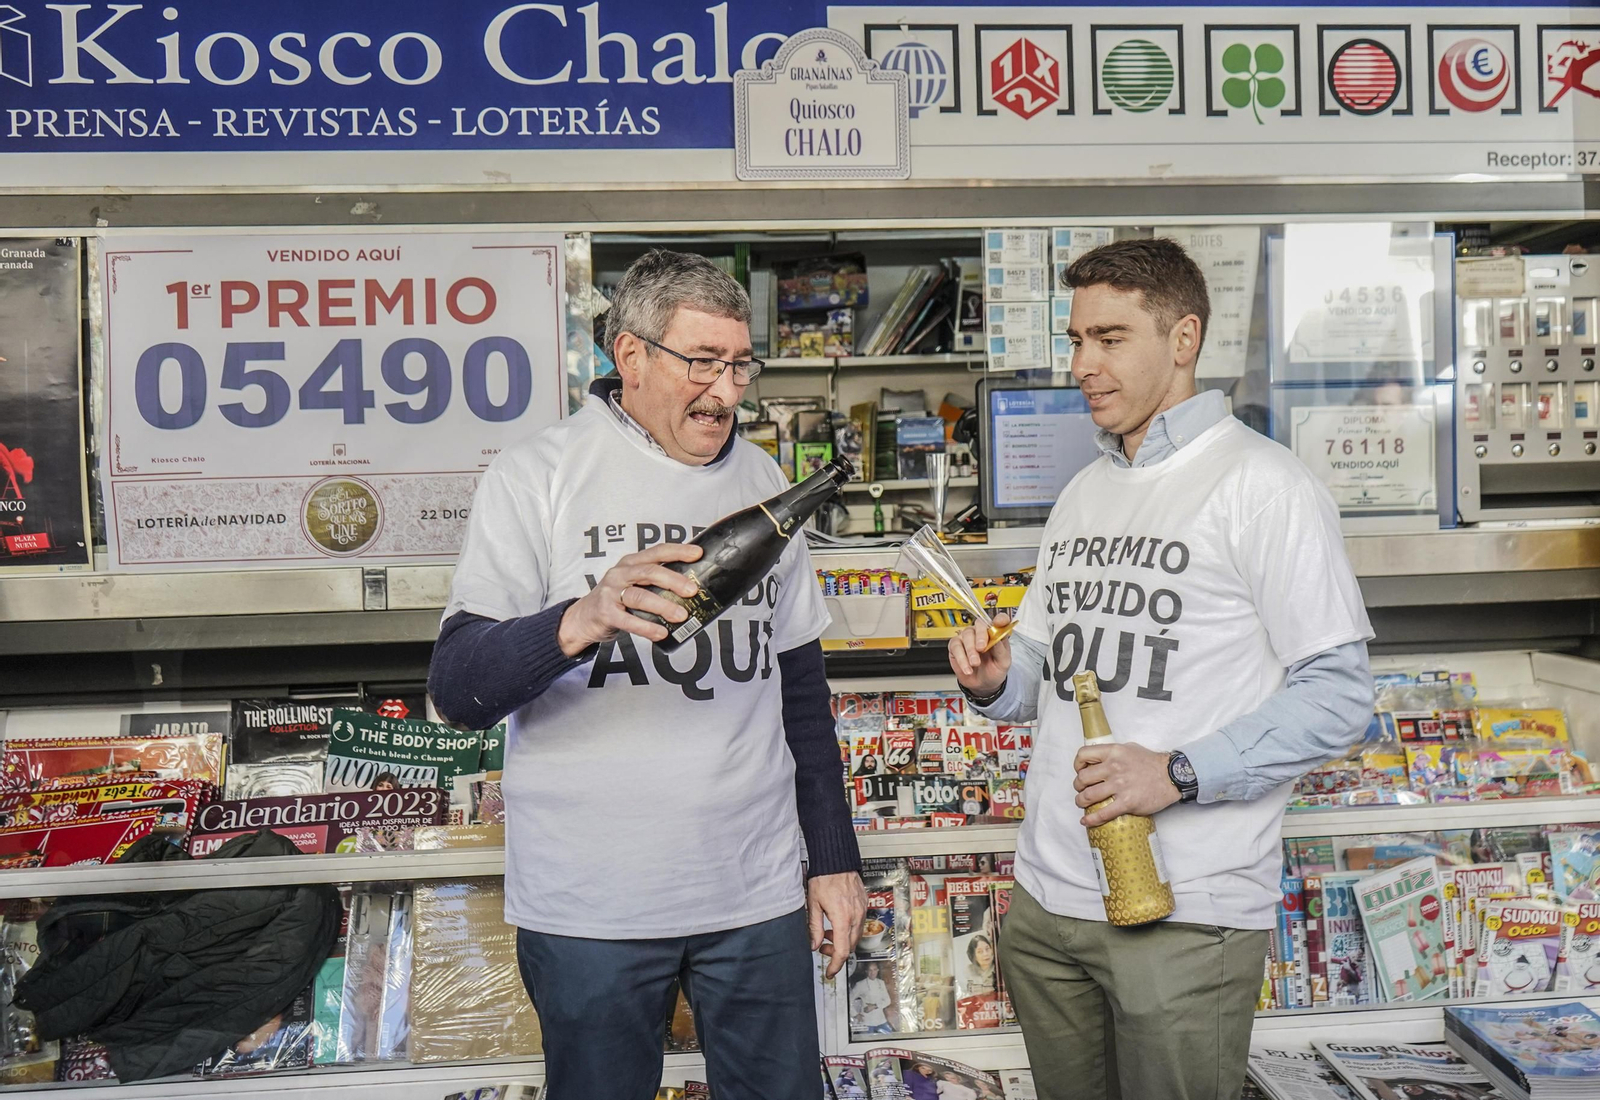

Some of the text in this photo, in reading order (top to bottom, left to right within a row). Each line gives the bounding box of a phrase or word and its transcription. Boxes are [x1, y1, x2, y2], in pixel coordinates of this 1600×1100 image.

[46, 3, 442, 85] Kiosco
[791, 65, 853, 81] GRANAÍNAS
[7, 99, 661, 138] PRENSA REVISTAS LOTERÍAS
[790, 98, 855, 123] Quiosco
[784, 128, 862, 156] CHALO
[1487, 151, 1572, 169] Receptor:
[1190, 234, 1223, 247] BOTES
[1, 248, 46, 258] Granada
[267, 246, 402, 262] VENDIDO AQUÍ
[166, 277, 497, 329] 1er PREMIO
[134, 336, 532, 430] 05490
[1325, 437, 1405, 455] 76118
[310, 458, 336, 466] LOTERÍA
[1330, 458, 1400, 469] VENDIDO AQUÍ
[137, 514, 200, 529] LOTERÍA
[217, 513, 287, 527] NAVIDAD
[421, 508, 472, 520] 22 DIC
[583, 523, 626, 558] 1er
[1068, 535, 1190, 575] PREMIO
[1045, 579, 1183, 625] VENDIDO
[587, 612, 774, 701] AQUÍ
[1042, 623, 1180, 702] QUÍ
[244, 709, 268, 728] THE
[268, 705, 318, 726] ROLLING
[269, 723, 319, 733] COLLECTION
[381, 720, 432, 734] REGALO
[360, 728, 478, 751] THE BODY SHOP
[352, 745, 366, 754] Gel
[368, 747, 387, 757] bath
[389, 752, 411, 760] blend
[421, 754, 454, 763] Champú
[888, 748, 912, 765] 66
[38, 783, 144, 806] ¡Feliz Navidad!
[200, 791, 438, 831] Calendario 2023
[339, 821, 360, 829] IDEAS
[383, 817, 420, 825] DISFRUTAR
[1456, 870, 1502, 888] SUDOKU
[1503, 910, 1559, 924] SUDOKU
[869, 1049, 909, 1057] ¡HOLA!
[1264, 1049, 1298, 1059] EL
[1327, 1042, 1412, 1056] Granada
